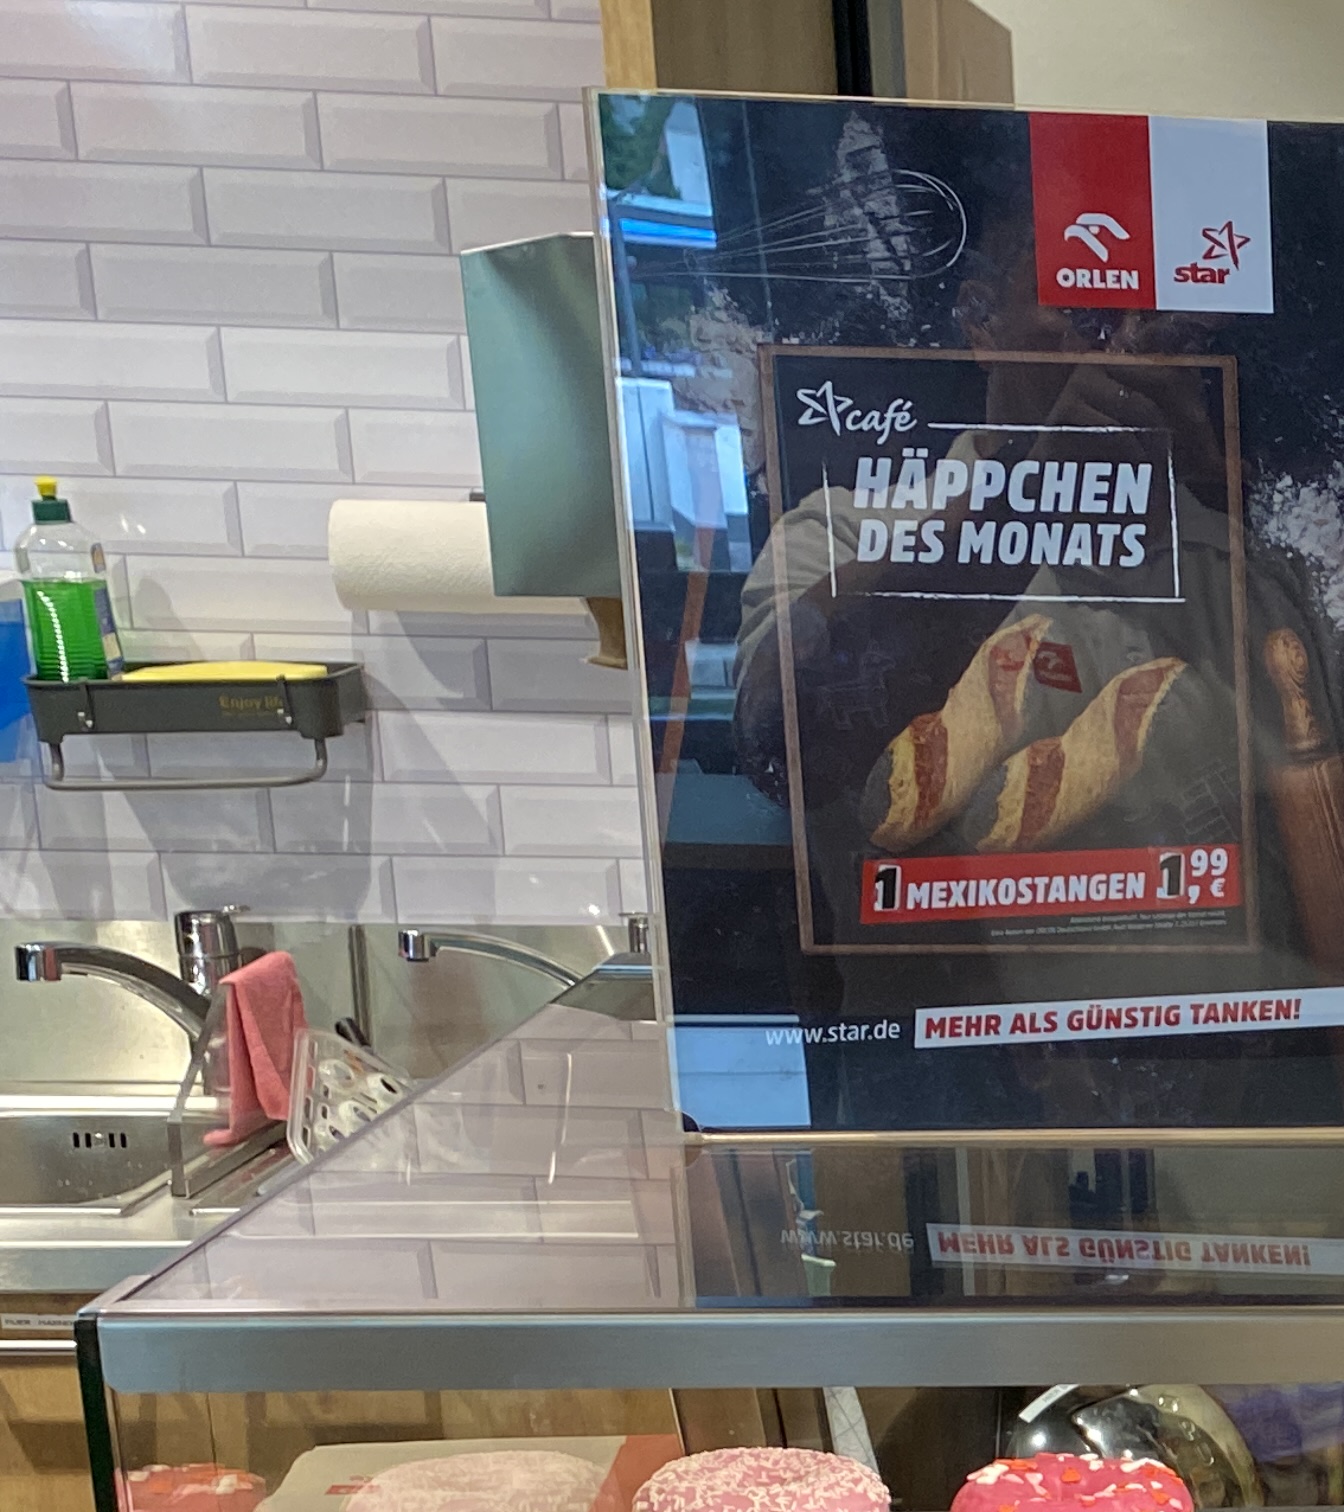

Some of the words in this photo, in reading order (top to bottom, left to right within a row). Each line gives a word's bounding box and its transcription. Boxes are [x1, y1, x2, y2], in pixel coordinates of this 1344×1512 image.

[1056, 268, 1139, 291] ORLEN
[1174, 263, 1231, 286] star
[847, 398, 917, 444] café
[853, 447, 1153, 516] HÄPPCHEN
[857, 519, 947, 564] DES
[958, 521, 1147, 568] MONATS
[906, 871, 1146, 910] MEXIKOSTANGEN
[764, 1019, 902, 1047] www.star.de
[924, 1012, 1002, 1040] MEHR
[1009, 1010, 1059, 1036] ALS
[1066, 1004, 1182, 1032] GÜNSTIG
[1190, 998, 1303, 1026] TANKEN!
